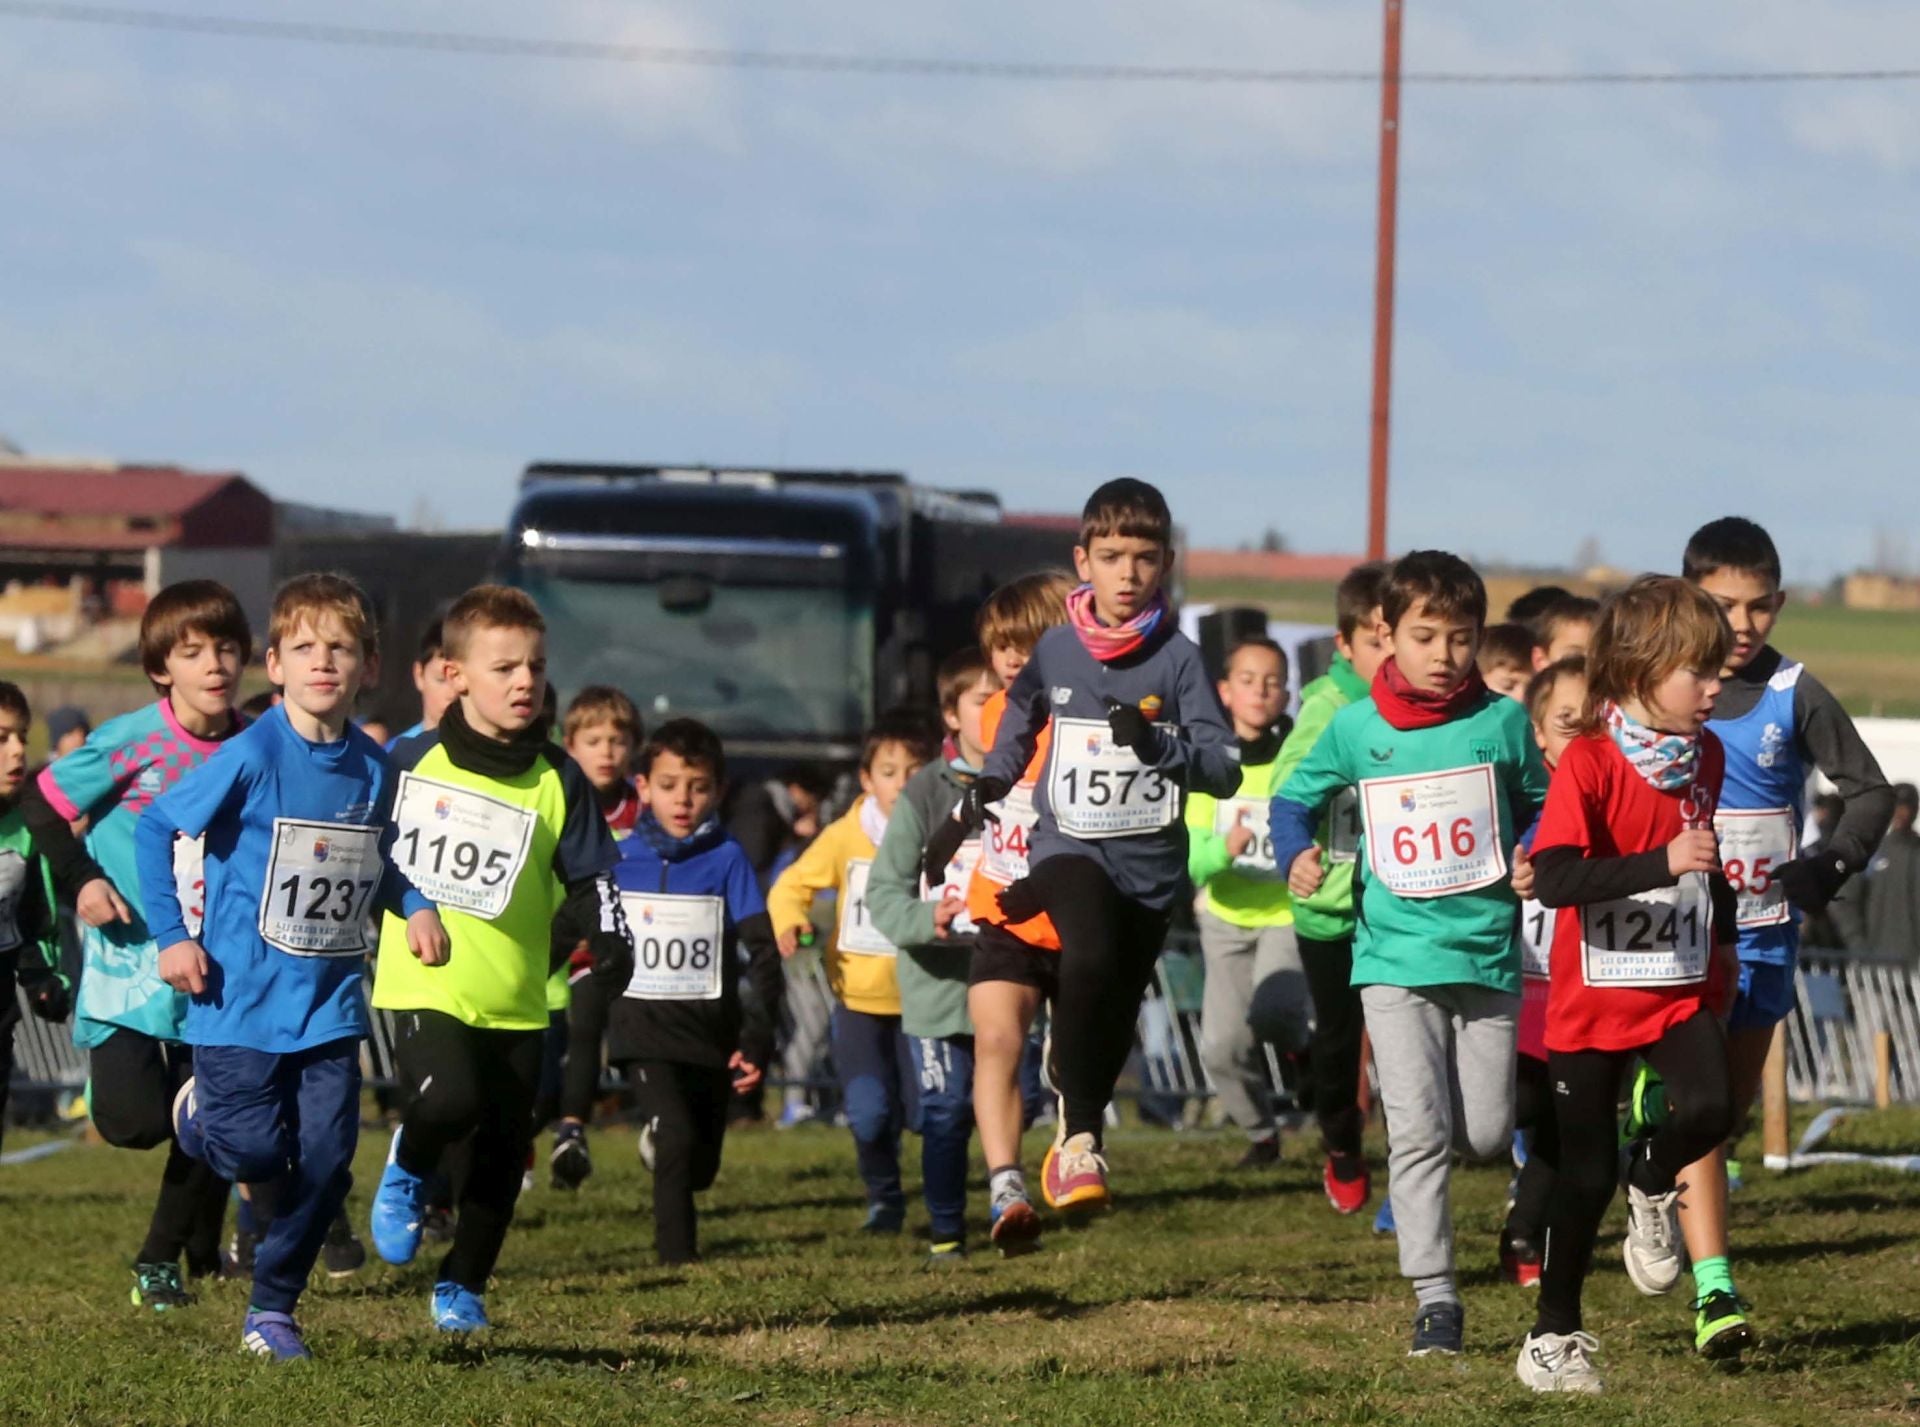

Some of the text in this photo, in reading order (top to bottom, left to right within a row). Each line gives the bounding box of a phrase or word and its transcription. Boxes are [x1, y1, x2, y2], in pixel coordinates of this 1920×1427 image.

[1062, 767, 1167, 806] 1573
[403, 827, 512, 886] 1195
[1392, 817, 1476, 866] 616
[280, 874, 375, 922] 1237
[1596, 905, 1698, 952] 1241
